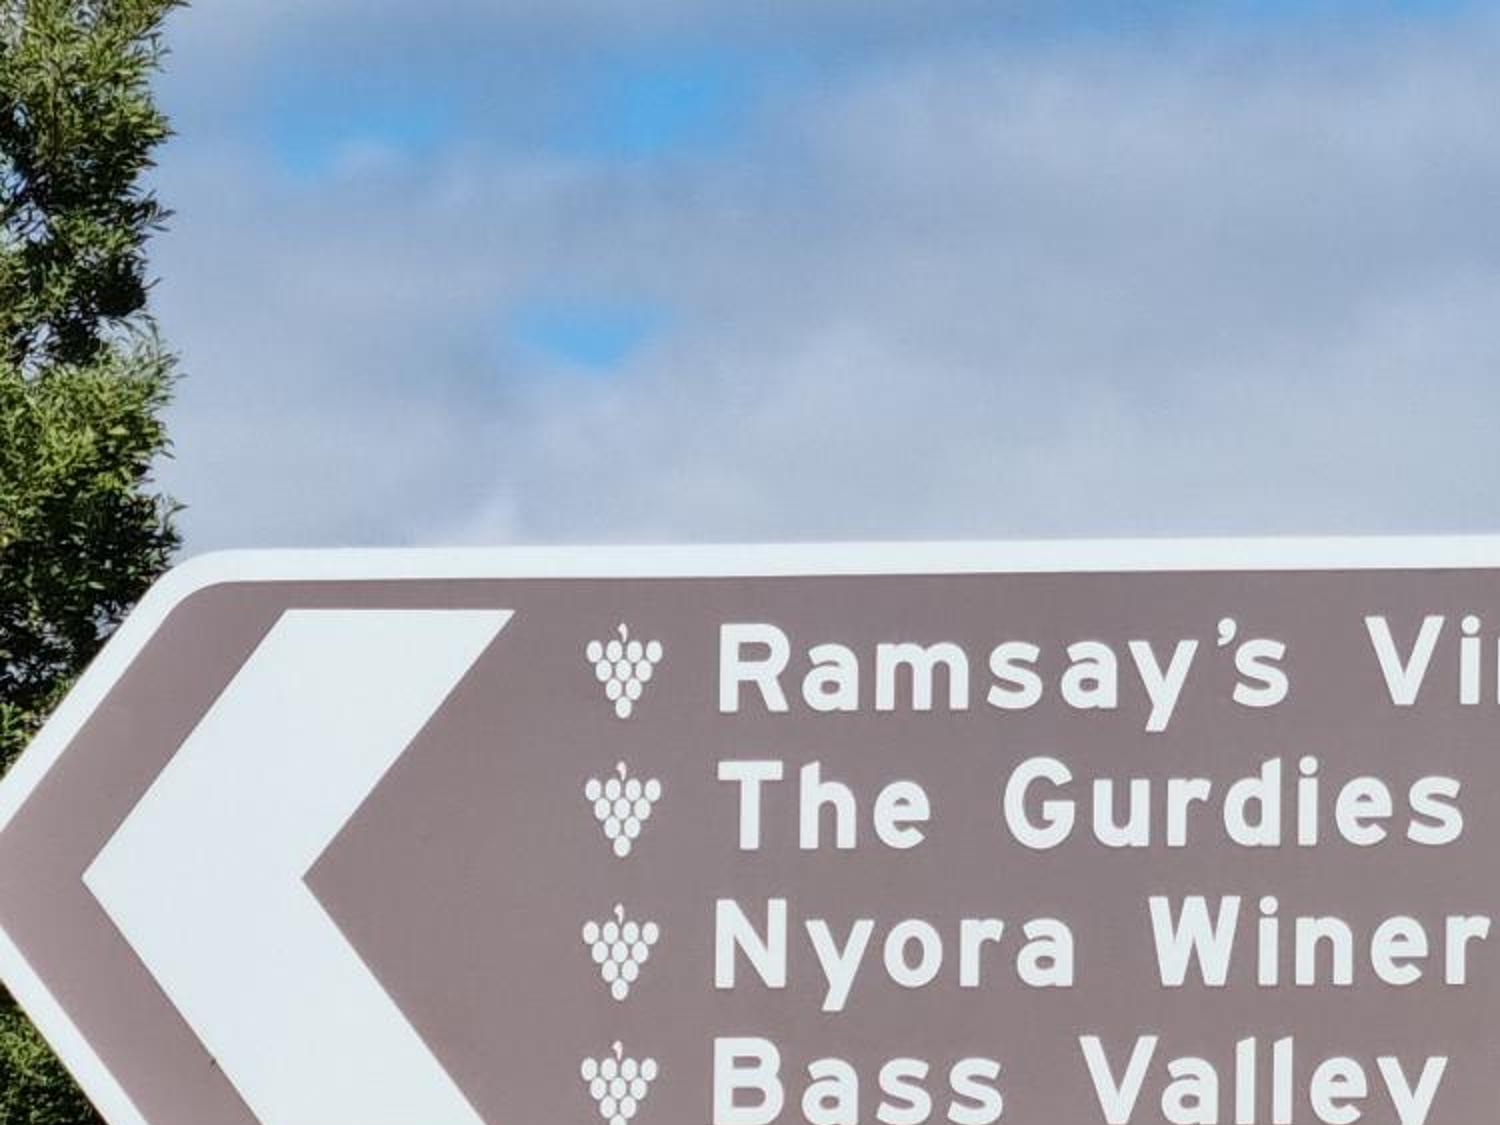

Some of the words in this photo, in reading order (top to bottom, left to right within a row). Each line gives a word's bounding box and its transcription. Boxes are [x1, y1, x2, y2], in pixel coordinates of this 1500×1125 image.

[719, 617, 1289, 732] Ramsay's
[717, 760, 931, 850] The
[1003, 755, 1464, 849] Gurdies
[715, 898, 1074, 1012] Nyora
